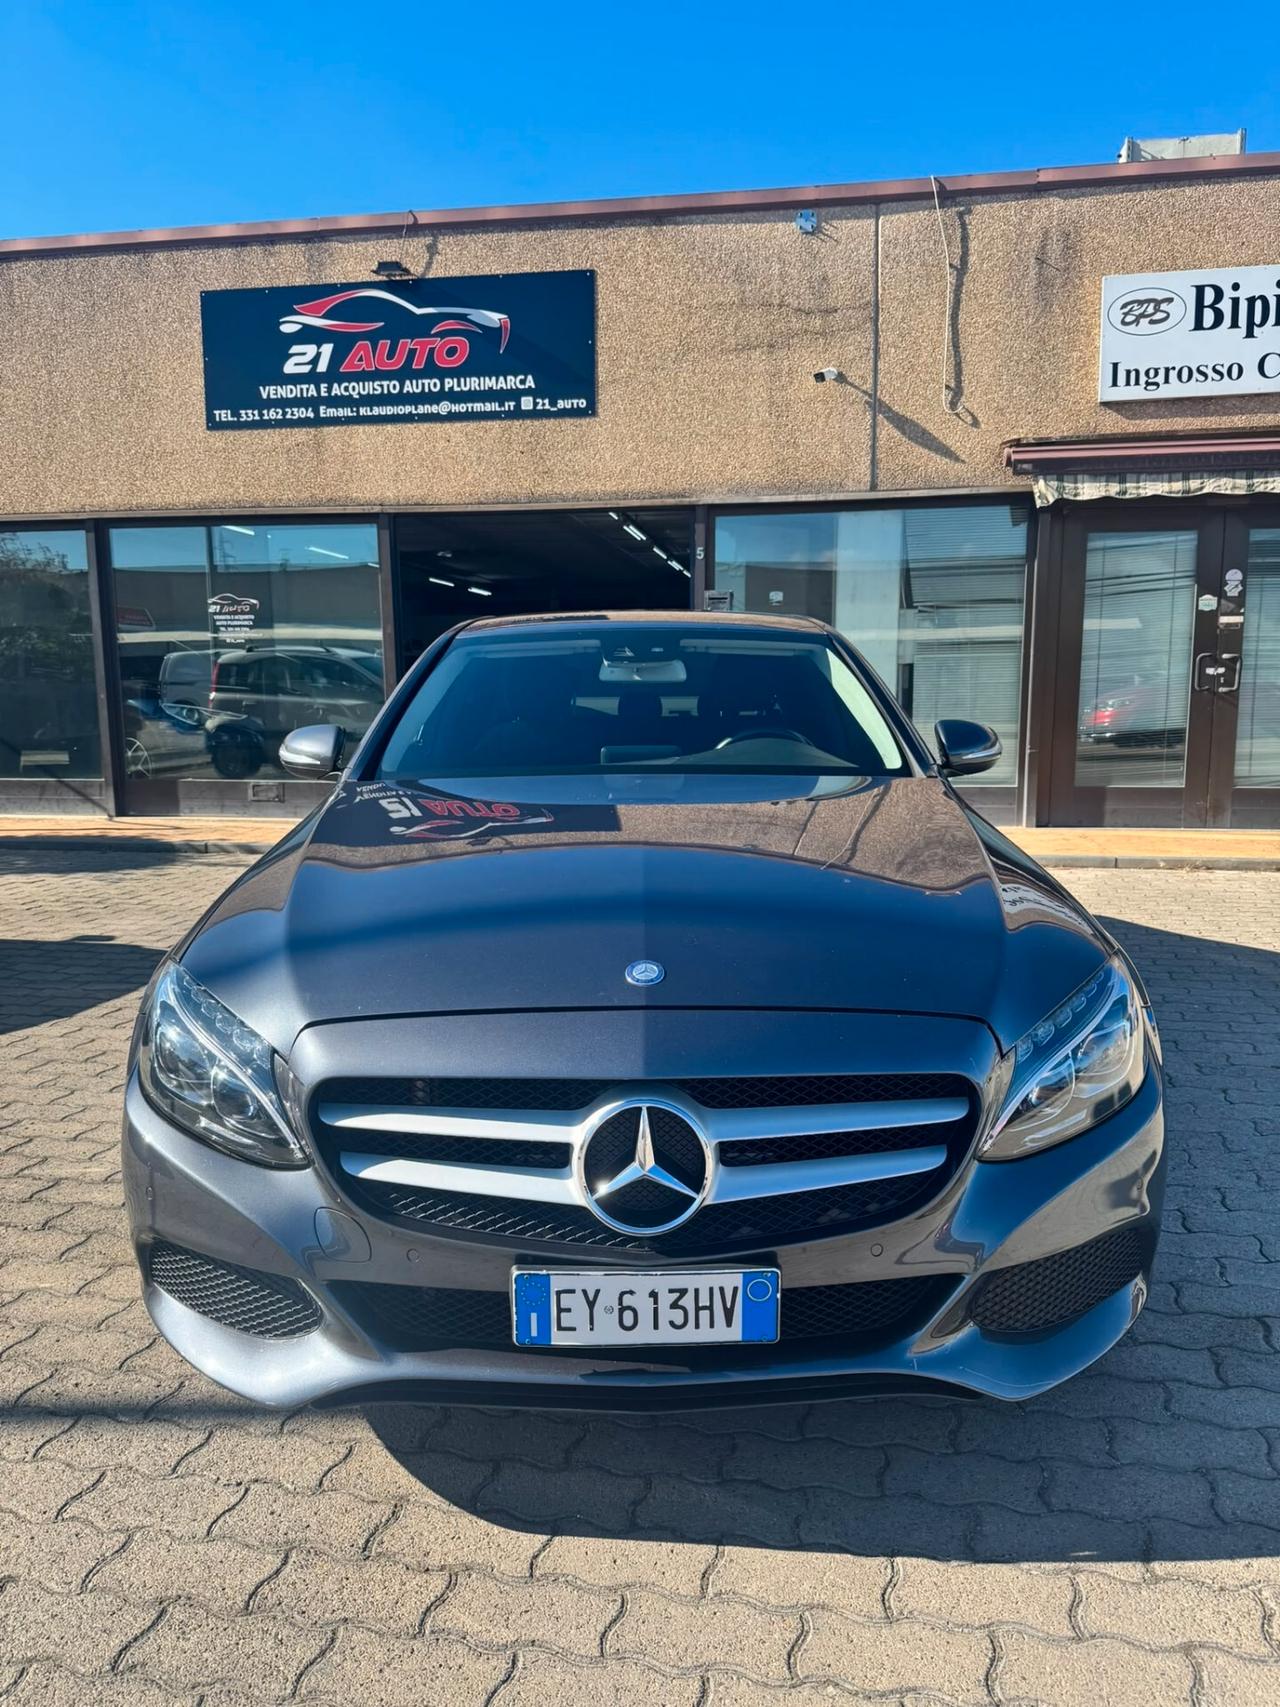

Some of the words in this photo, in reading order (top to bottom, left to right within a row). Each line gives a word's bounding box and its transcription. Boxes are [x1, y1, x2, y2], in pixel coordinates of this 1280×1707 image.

[282, 343, 334, 374] 21
[339, 336, 470, 372] AUTO
[259, 384, 318, 399] VENDITA
[320, 383, 328, 396] E
[331, 380, 400, 398] ACQUISTO
[403, 378, 440, 394] AUTO
[444, 374, 535, 392] PLURIMARCA
[1108, 361, 1244, 392] Ingrosso
[213, 410, 237, 421] TEL.
[239, 409, 260, 421] 331
[262, 408, 283, 420] 162
[285, 407, 314, 419] 2304
[696, 547, 704, 560] 5
[554, 1288, 601, 1332] EY
[617, 1286, 739, 1332] 613HV
